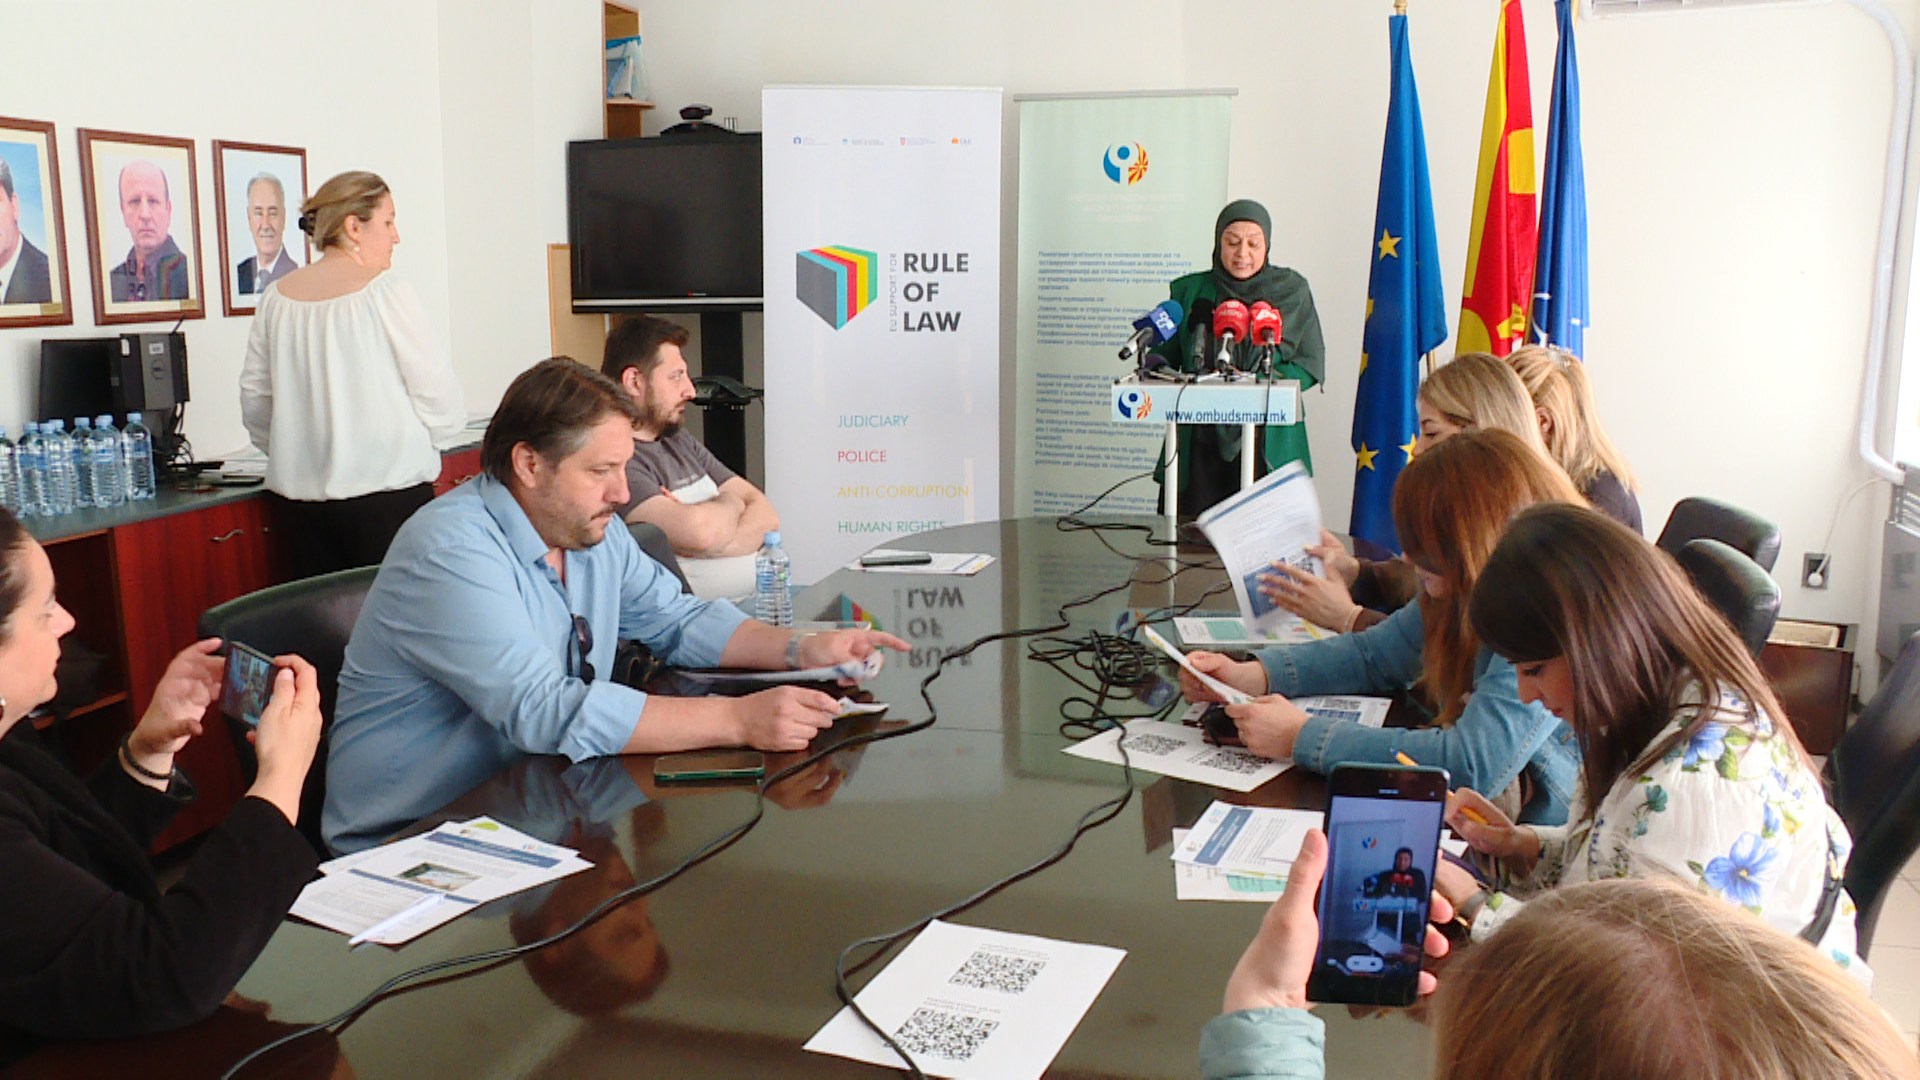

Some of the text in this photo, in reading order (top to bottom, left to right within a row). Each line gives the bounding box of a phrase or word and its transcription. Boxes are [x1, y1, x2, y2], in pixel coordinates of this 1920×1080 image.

[889, 253, 898, 272] FOR
[903, 253, 969, 272] RULE
[889, 275, 898, 317] SUPPORT
[903, 282, 939, 302] OF
[903, 311, 961, 332] LAW
[838, 415, 909, 428] JUDICIARY
[1165, 409, 1286, 422] www.ombudsman.mk
[838, 450, 887, 463] POLICE
[838, 521, 892, 533] HUMAN
